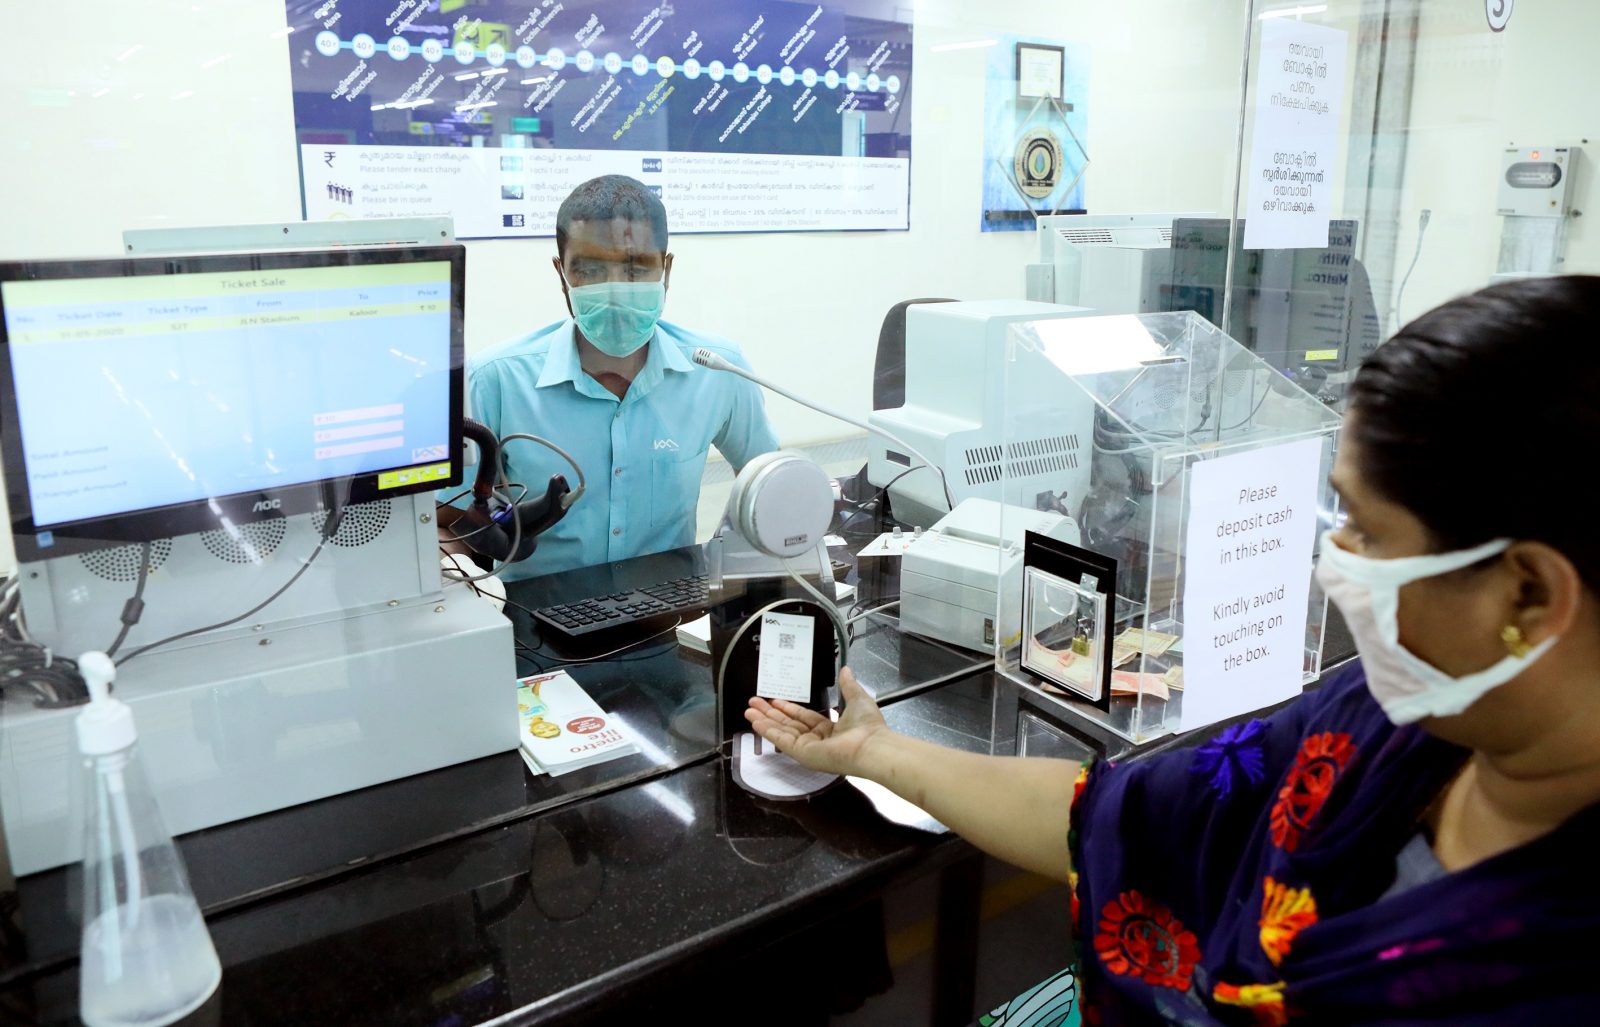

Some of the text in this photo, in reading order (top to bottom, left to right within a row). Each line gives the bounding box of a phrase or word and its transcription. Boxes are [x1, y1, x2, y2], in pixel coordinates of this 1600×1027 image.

[522, 3, 565, 45] Cochin University
[1288, 42, 1324, 60] ദയവായി
[1283, 59, 1327, 79] ബോക്സിൽ
[609, 84, 623, 98] Park
[1290, 81, 1315, 95] പണം
[1270, 92, 1329, 115] നിക്ഷേപിക്കുക
[1273, 150, 1317, 168] ബോക്സിൽ
[360, 165, 462, 176] Please tender exact change
[1273, 183, 1312, 198] ദയവായി
[362, 196, 387, 204] Please
[221, 277, 287, 289] Ticket Sale
[358, 293, 370, 301] To
[417, 289, 439, 297] Price
[147, 304, 208, 315] Ticket Type
[256, 299, 283, 308] From
[57, 310, 123, 321] Ticket Date
[259, 314, 300, 325] Stadium
[348, 308, 379, 317] Kaloor
[62, 446, 108, 457] Amount
[62, 465, 107, 477] Amount
[37, 480, 128, 499] Change Amount
[1238, 484, 1278, 504] Please
[252, 498, 281, 513] AOC
[1216, 505, 1293, 539] deposit cash
[1220, 535, 1285, 565] in this box.
[1213, 583, 1285, 621] Kindly avoid
[1214, 613, 1283, 649] touching on
[1223, 643, 1271, 671] the box.
[589, 729, 618, 740] life
[570, 735, 624, 753] metro
